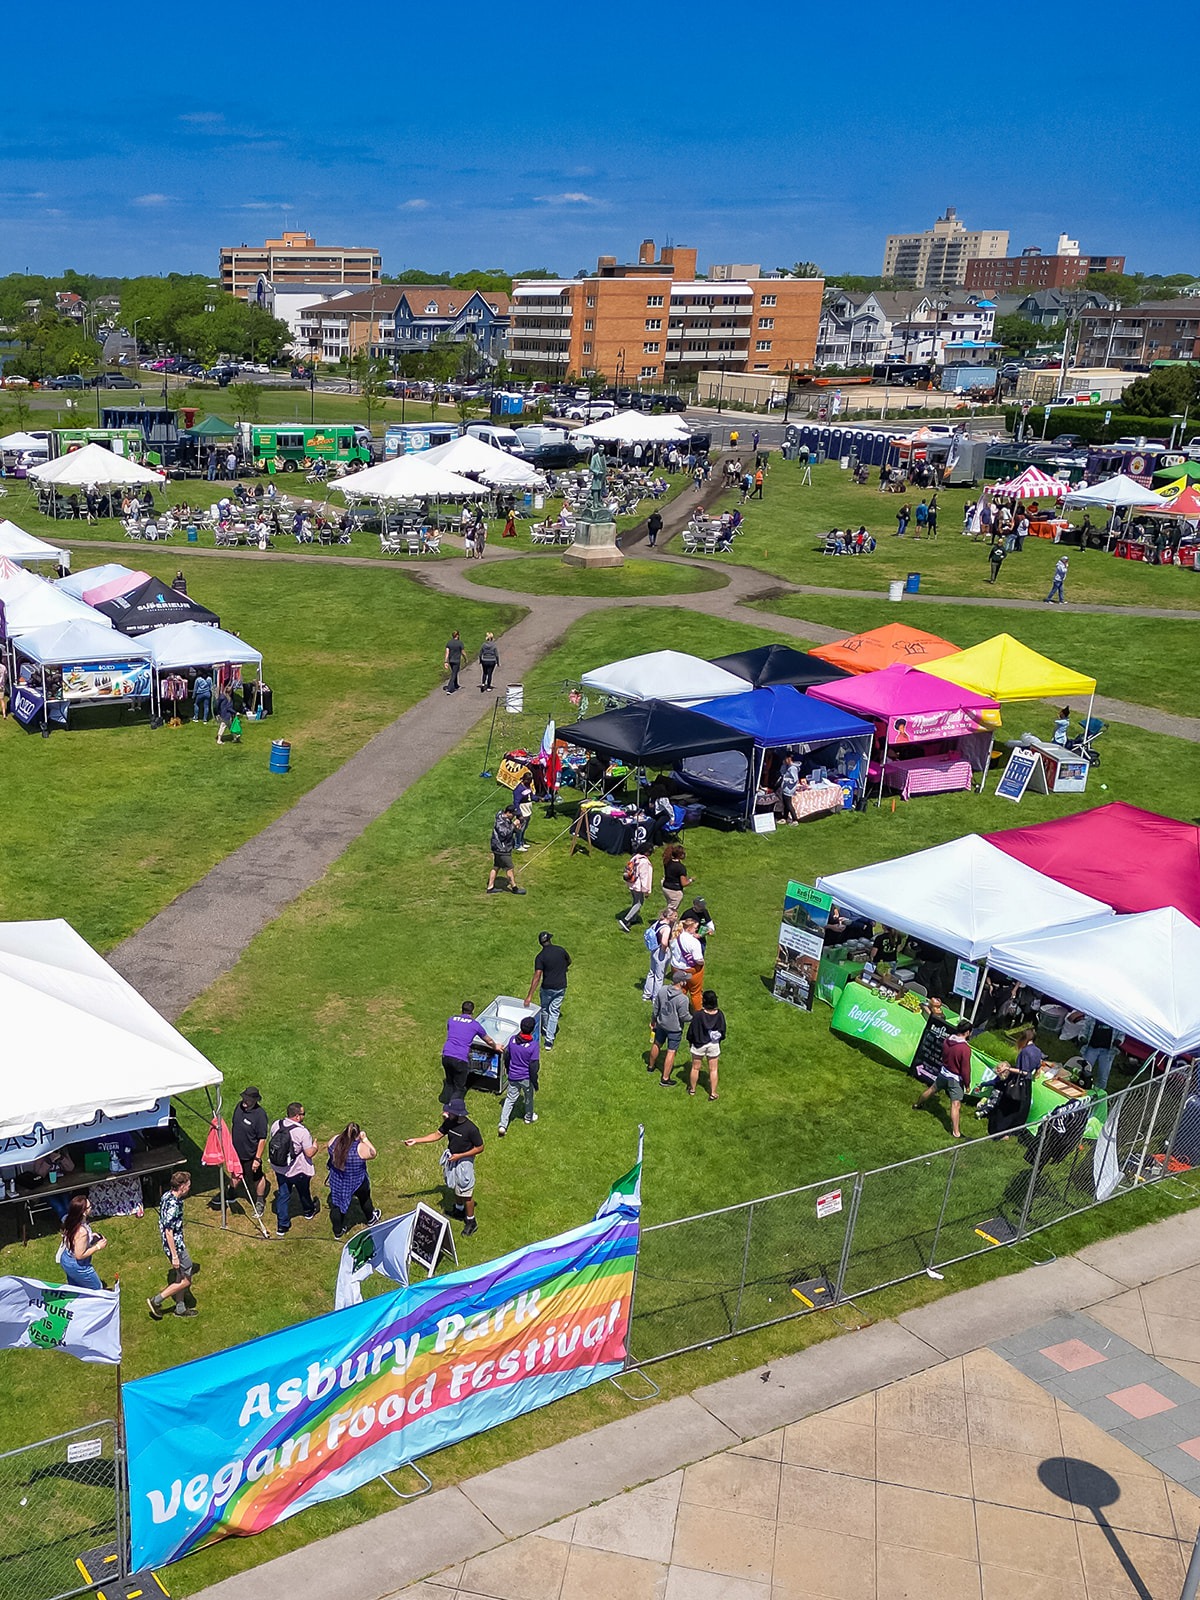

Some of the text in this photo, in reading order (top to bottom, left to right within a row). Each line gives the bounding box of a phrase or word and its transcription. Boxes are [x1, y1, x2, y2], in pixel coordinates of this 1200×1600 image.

[848, 1004, 901, 1037] Redifarms
[0, 1127, 55, 1153] ASH
[45, 1289, 66, 1300] THE
[29, 1299, 74, 1321] FUTURE
[29, 1326, 67, 1347] VEGAN
[42, 1319, 53, 1330] IS
[238, 1289, 541, 1427] Asbury Park
[146, 1300, 621, 1524] Vegan Food Festival
